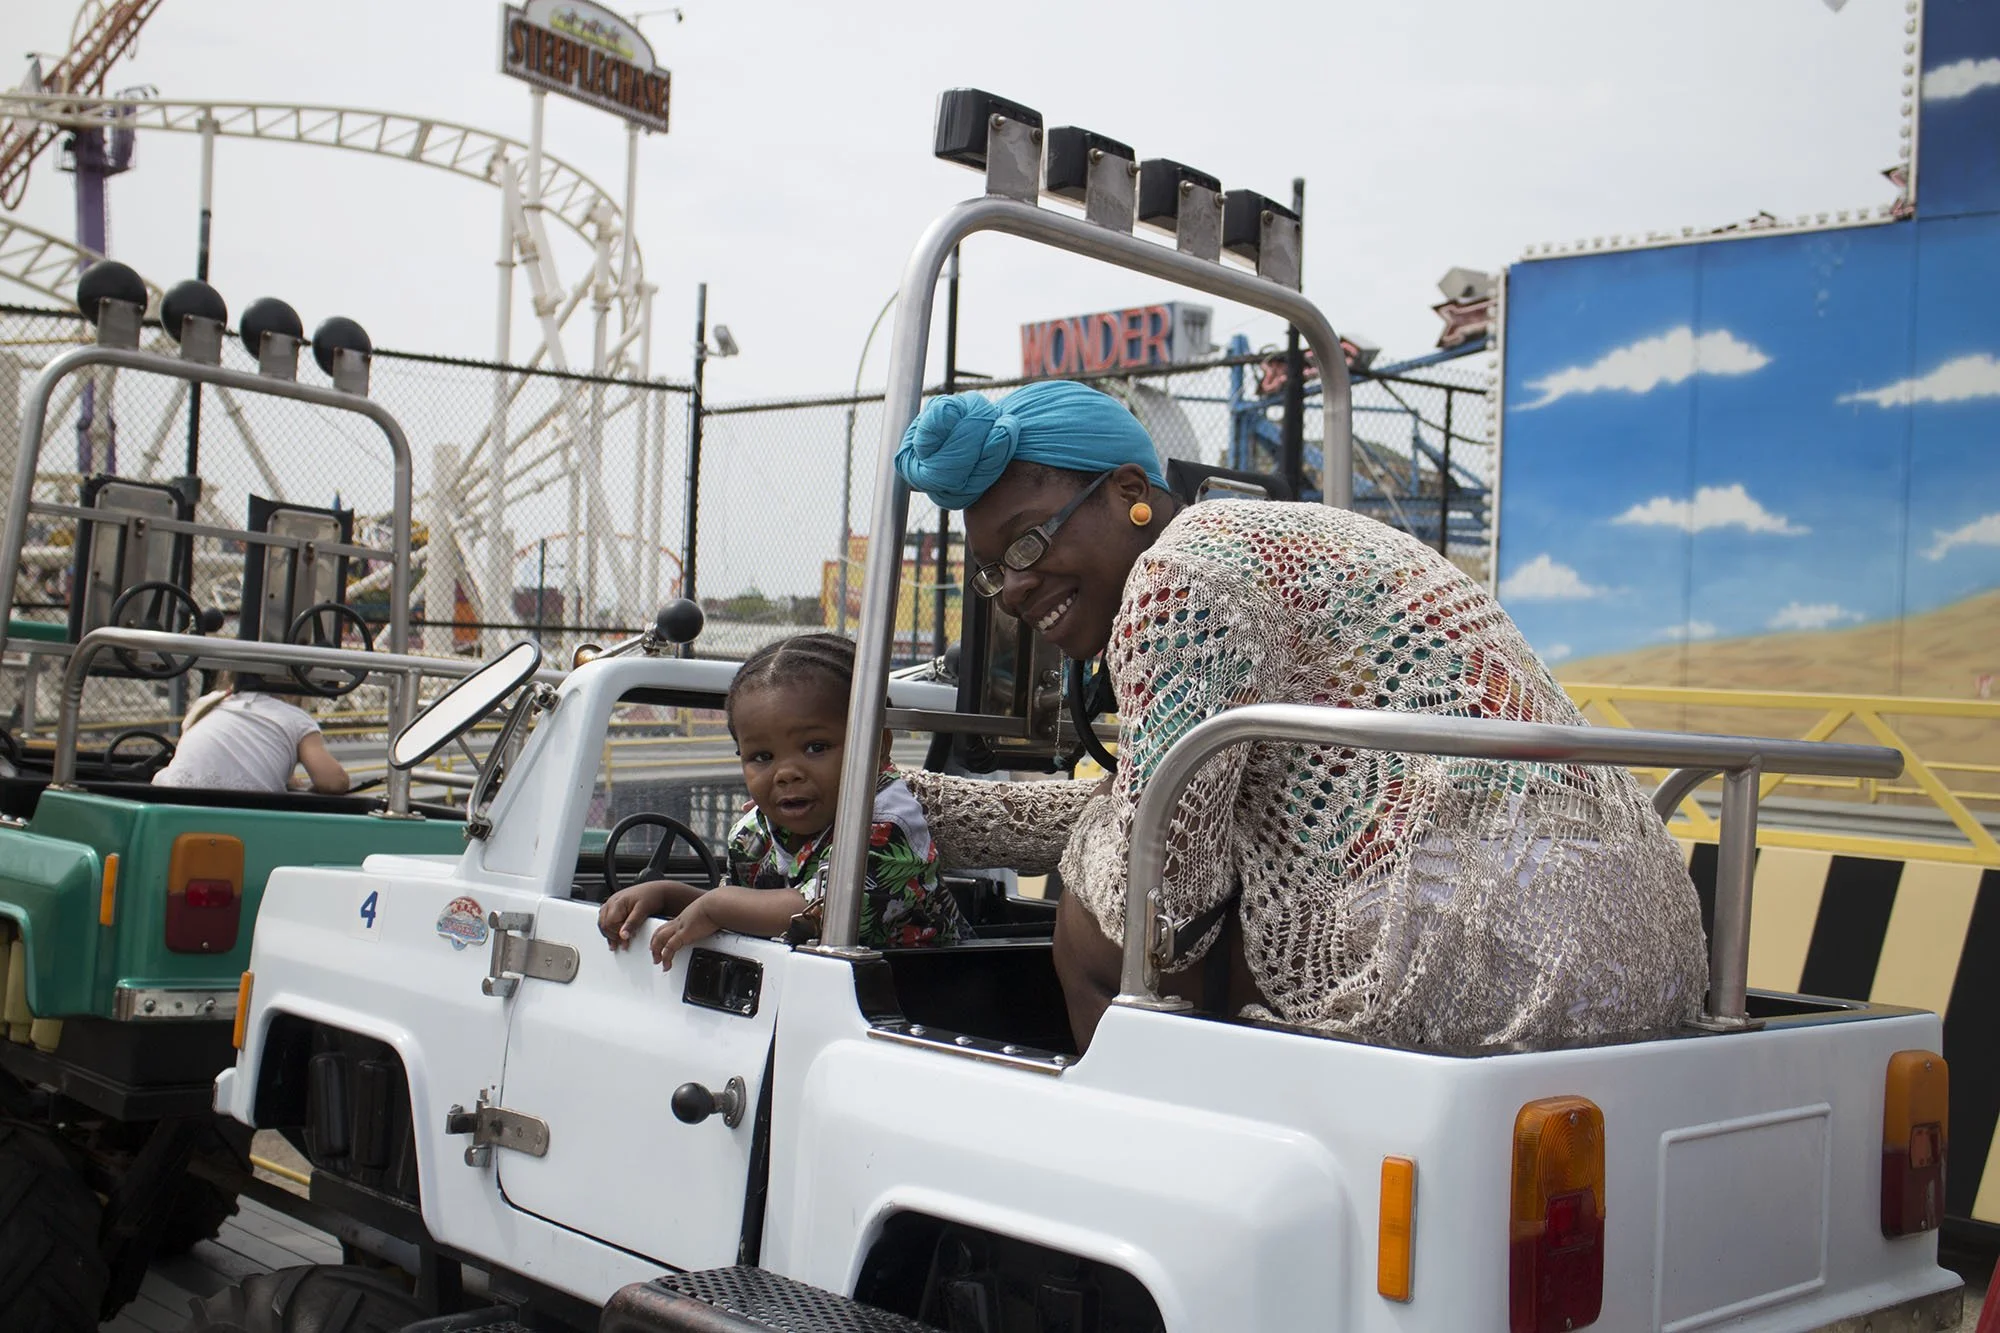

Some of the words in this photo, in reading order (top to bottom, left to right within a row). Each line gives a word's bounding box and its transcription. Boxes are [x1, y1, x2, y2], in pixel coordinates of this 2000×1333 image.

[509, 18, 669, 121] STEEPLECHASE
[1020, 304, 1171, 377] WONDER
[360, 890, 379, 929] 4
